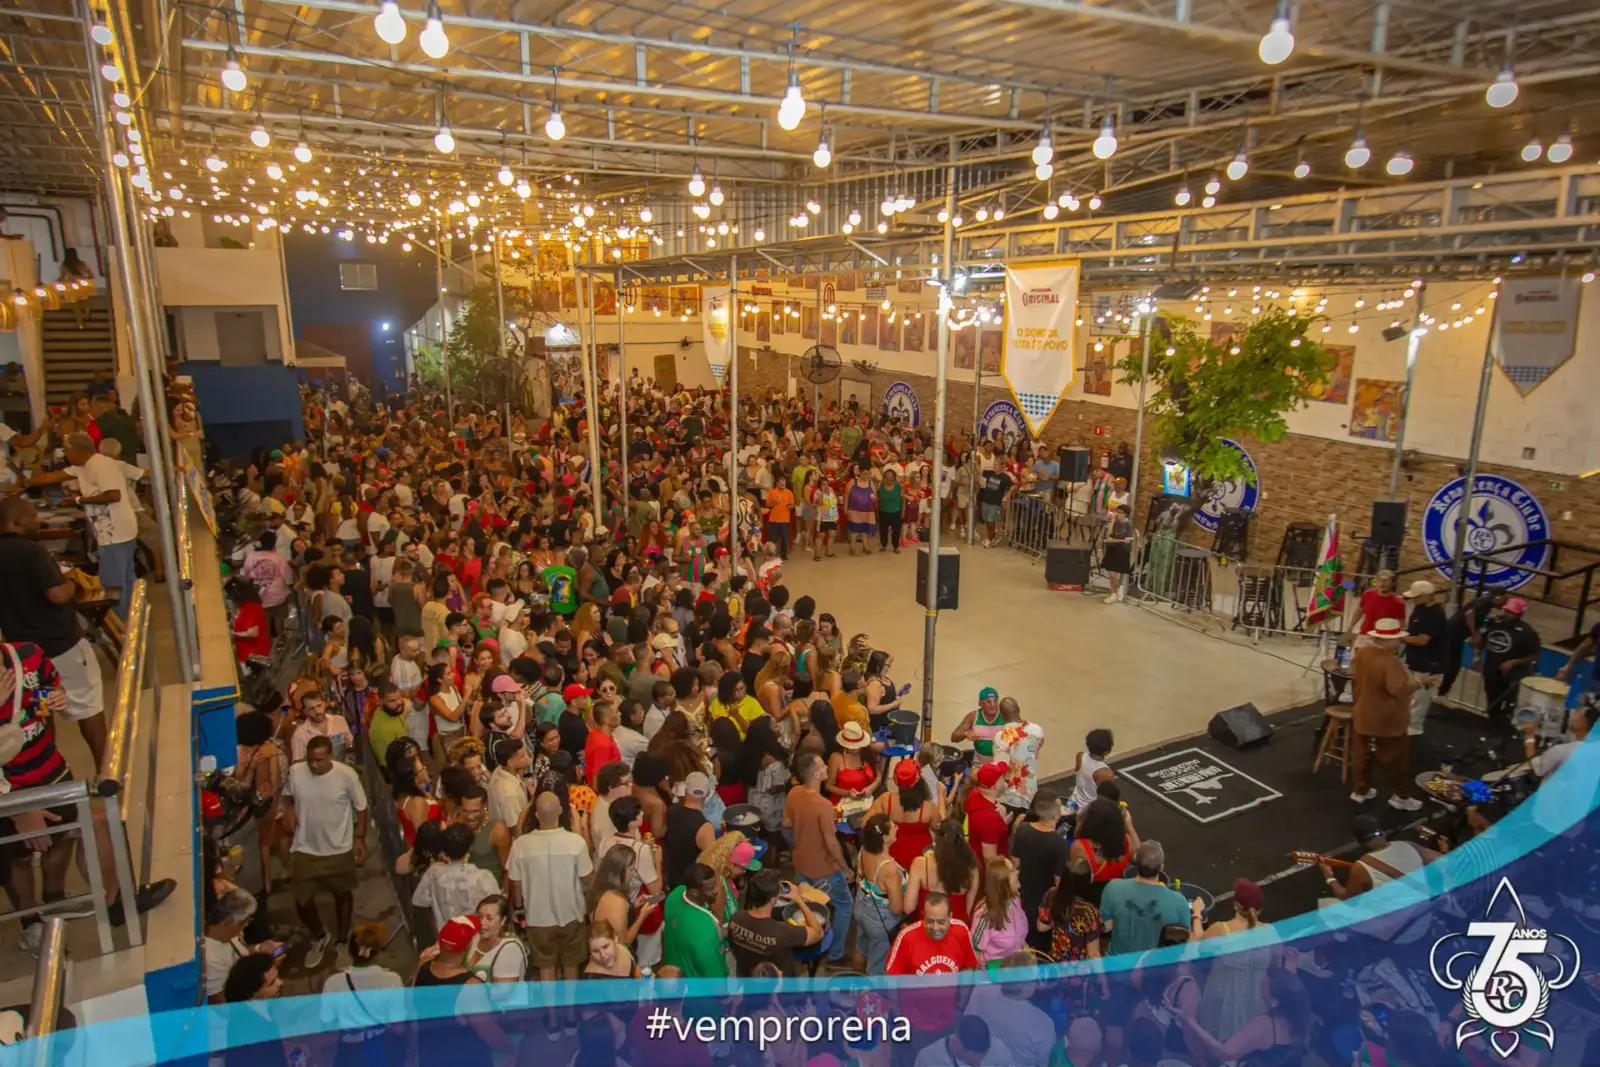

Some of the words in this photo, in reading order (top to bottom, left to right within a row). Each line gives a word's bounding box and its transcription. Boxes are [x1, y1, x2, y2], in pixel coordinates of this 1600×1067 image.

[1431, 481, 1512, 514] Renaença
[1511, 490, 1541, 532] Clube
[755, 934, 777, 946] DAYS
[915, 955, 959, 976] SALGUEIRO
